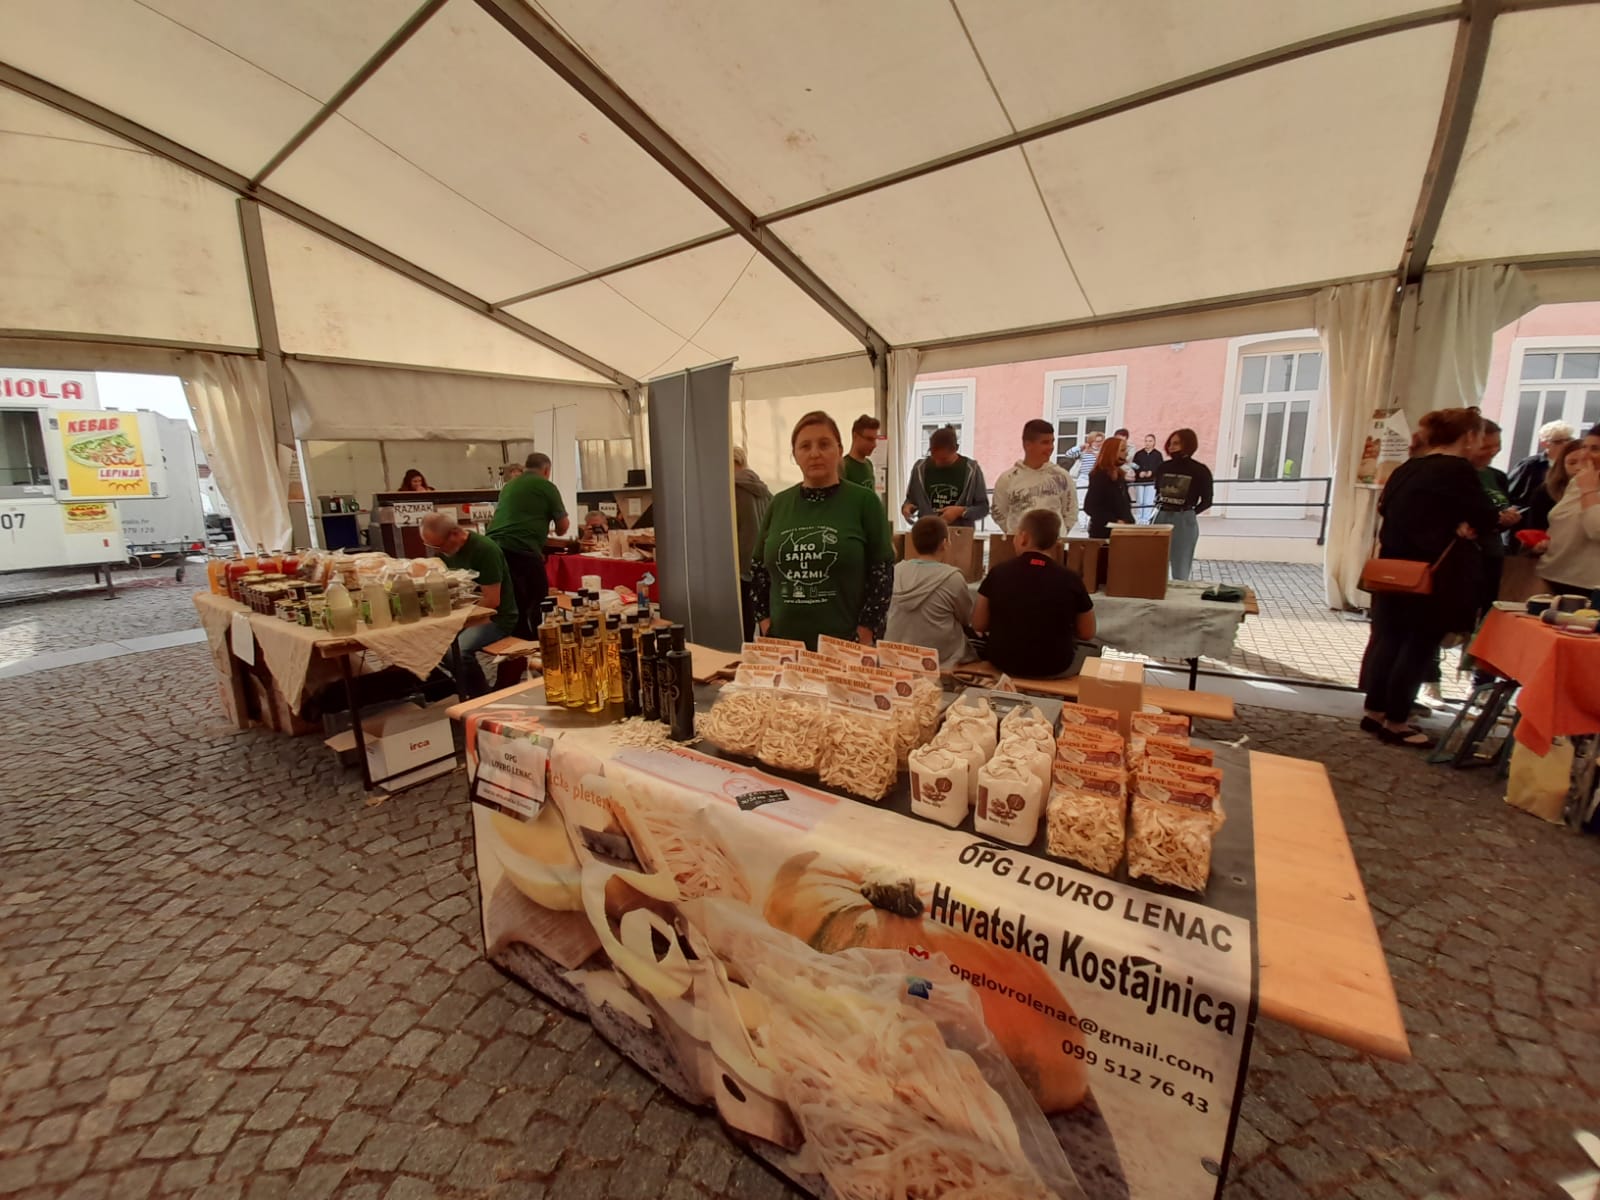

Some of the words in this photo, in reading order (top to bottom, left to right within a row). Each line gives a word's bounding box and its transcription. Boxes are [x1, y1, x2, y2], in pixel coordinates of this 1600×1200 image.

[0, 377, 83, 400] IOLA
[67, 417, 119, 433] KEBAB
[100, 469, 141, 478] LEPINJA
[394, 503, 433, 513] RAZMAK
[472, 510, 493, 519] KAVA
[793, 543, 816, 552] EKO
[785, 552, 822, 562] SAJAM
[800, 561, 808, 570] U
[958, 844, 1014, 877] OPG
[1017, 865, 1114, 912] LOVRO
[1123, 898, 1233, 953] LENAC
[929, 882, 1050, 965] Hrvatska
[1059, 930, 1237, 1036] Kostajnica
[950, 964, 1215, 1083] opglovrolenac@gmail.com
[1062, 1039, 1098, 1066] 099
[1103, 1058, 1142, 1085] 512
[1149, 1075, 1175, 1097] 76
[1181, 1090, 1209, 1114] 43
